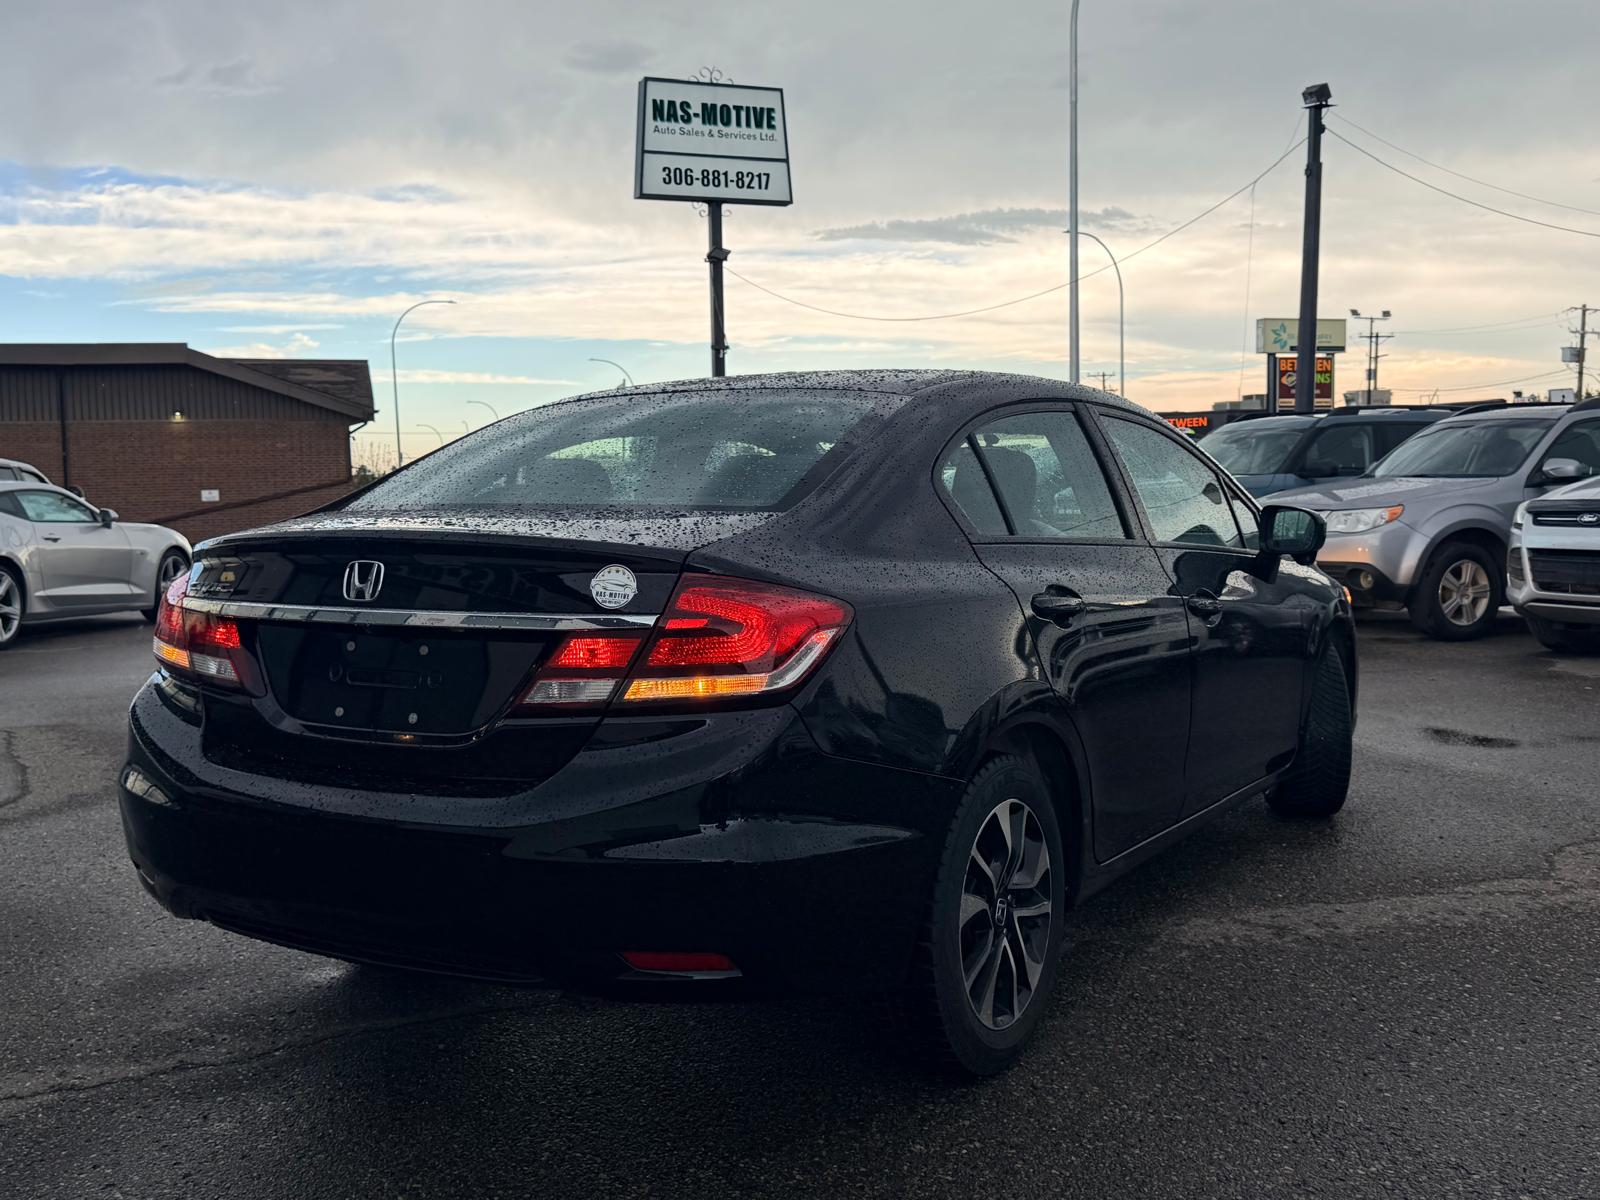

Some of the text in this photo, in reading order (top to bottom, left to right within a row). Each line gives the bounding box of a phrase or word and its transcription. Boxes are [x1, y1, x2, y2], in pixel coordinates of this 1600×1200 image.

[652, 99, 776, 130] NAS-MOTIVE
[653, 125, 777, 142] Auto Sales & Services Ltd.
[662, 166, 770, 190] 306-881-8217
